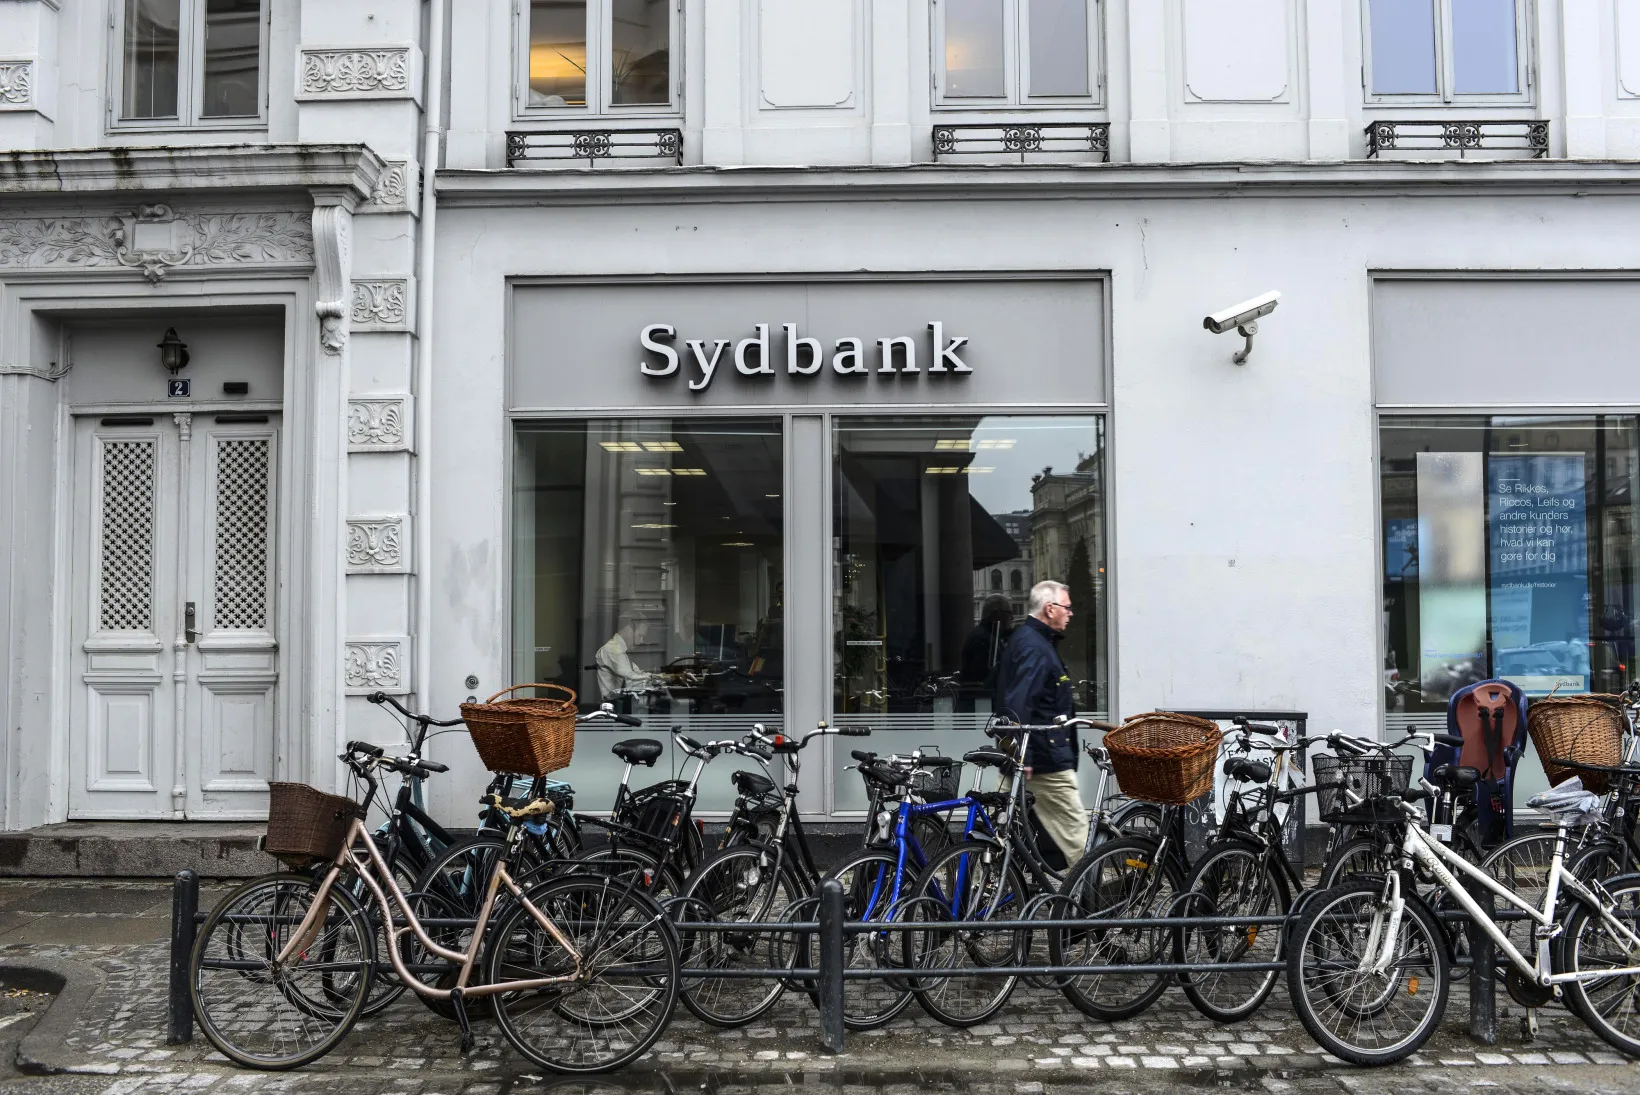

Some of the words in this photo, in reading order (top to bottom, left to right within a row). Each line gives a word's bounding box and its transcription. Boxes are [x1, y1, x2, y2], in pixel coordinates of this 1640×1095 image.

[640, 320, 974, 393] Sydbank
[175, 381, 183, 395] 2
[1499, 483, 1512, 493] Se
[1514, 483, 1549, 495] Rikkes,
[1499, 497, 1534, 508] Riccos,
[1537, 497, 1560, 507] Leifs
[1562, 498, 1575, 509] og
[1499, 510, 1527, 520] andre
[1529, 510, 1569, 520] kunders
[1500, 524, 1537, 534] historier
[1539, 526, 1553, 536] og
[1555, 524, 1573, 535] hør,
[1500, 537, 1523, 547] hvad
[1525, 538, 1534, 547] vi
[1536, 537, 1555, 547] kan
[1500, 552, 1523, 563] gøre
[1525, 551, 1538, 560] for
[1540, 551, 1556, 563] dig
